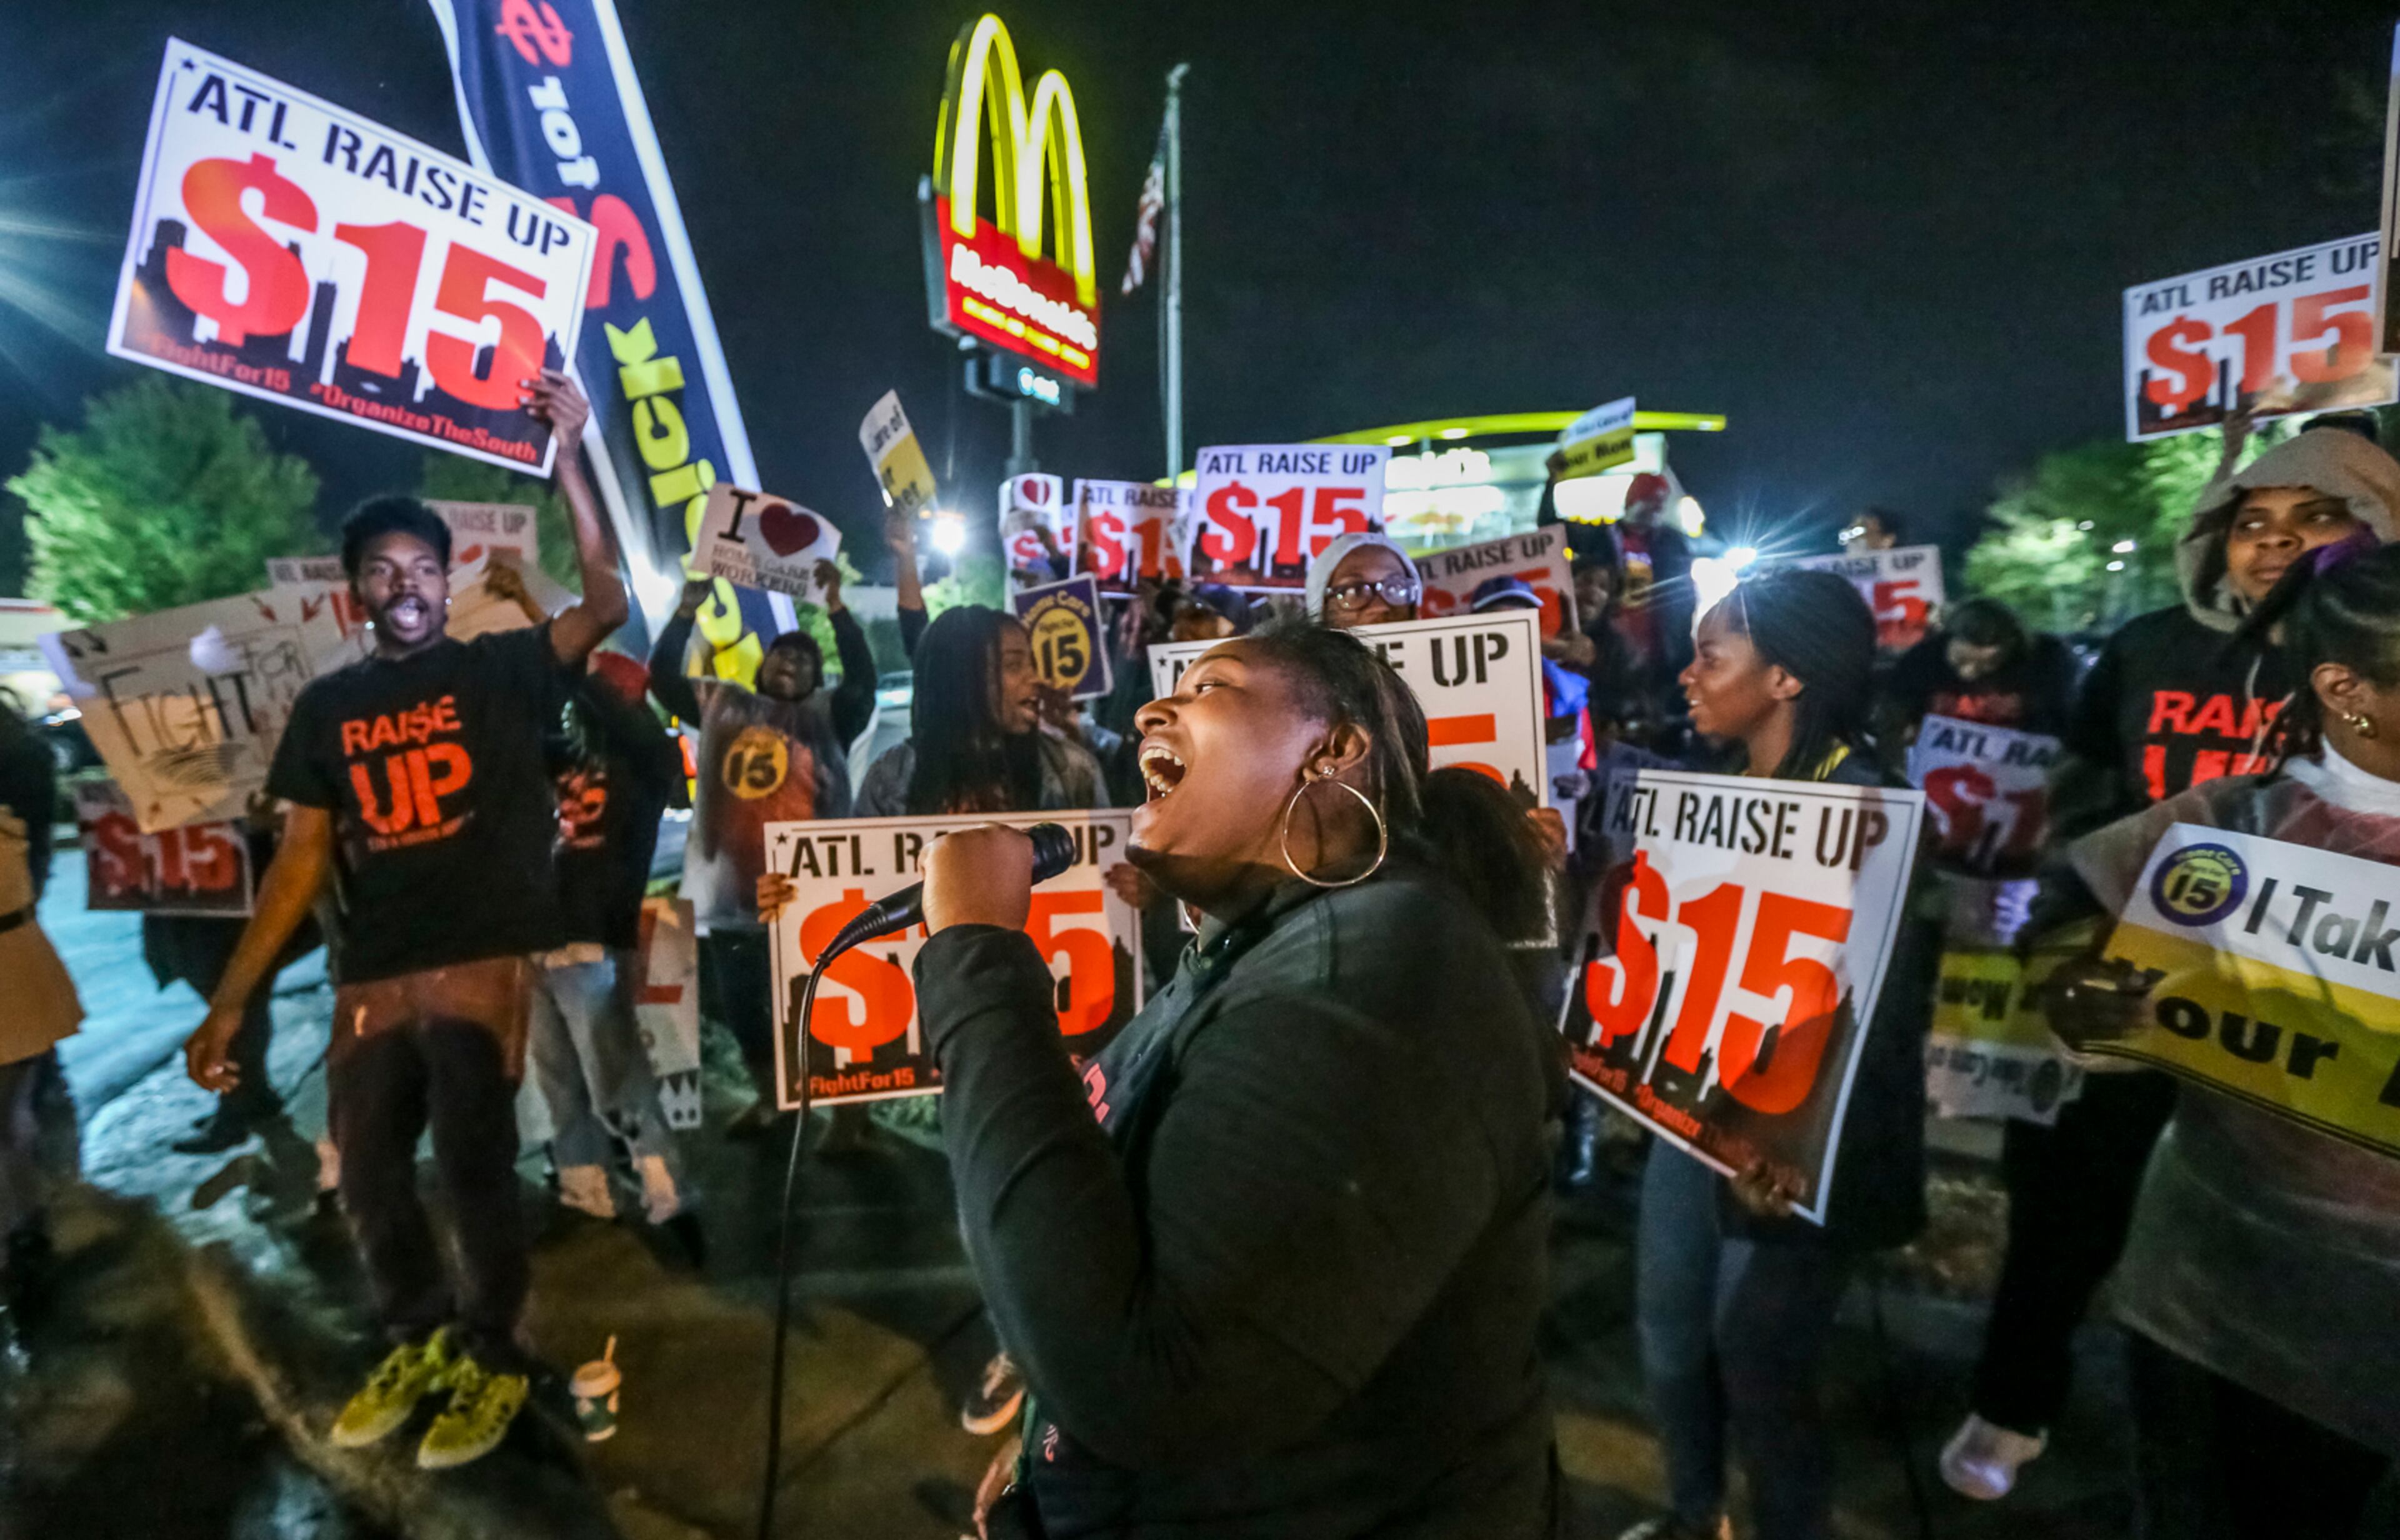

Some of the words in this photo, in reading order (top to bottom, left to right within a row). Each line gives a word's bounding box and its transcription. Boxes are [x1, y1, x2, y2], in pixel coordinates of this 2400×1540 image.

[188, 73, 297, 152] ATL
[322, 121, 489, 226] RAISE
[507, 203, 571, 256] UP
[165, 151, 548, 411] $15
[2140, 291, 2196, 316] ATL
[2208, 254, 2316, 302] RAISE
[2331, 241, 2379, 275] UP
[2146, 284, 2374, 413] $15
[311, 381, 538, 462] #OrganizeTheSouth
[1206, 452, 1248, 474] ATL
[1258, 452, 1332, 474] RAISE
[1342, 452, 1378, 474] UP
[717, 488, 758, 544] I
[1201, 480, 1369, 569] $15
[1444, 539, 1514, 576] RAISE
[1521, 533, 1555, 559] UP
[1041, 634, 1084, 680] 15
[1430, 632, 1509, 688] UP
[2148, 690, 2286, 739] RAI
[349, 741, 472, 834] UP
[727, 750, 778, 789] 15
[790, 835, 874, 879] ATL
[1674, 792, 1801, 860] RAISE
[1815, 806, 1889, 872] UP
[2169, 874, 2221, 909] 15
[2244, 876, 2279, 935] I
[1586, 849, 1854, 1114] $15
